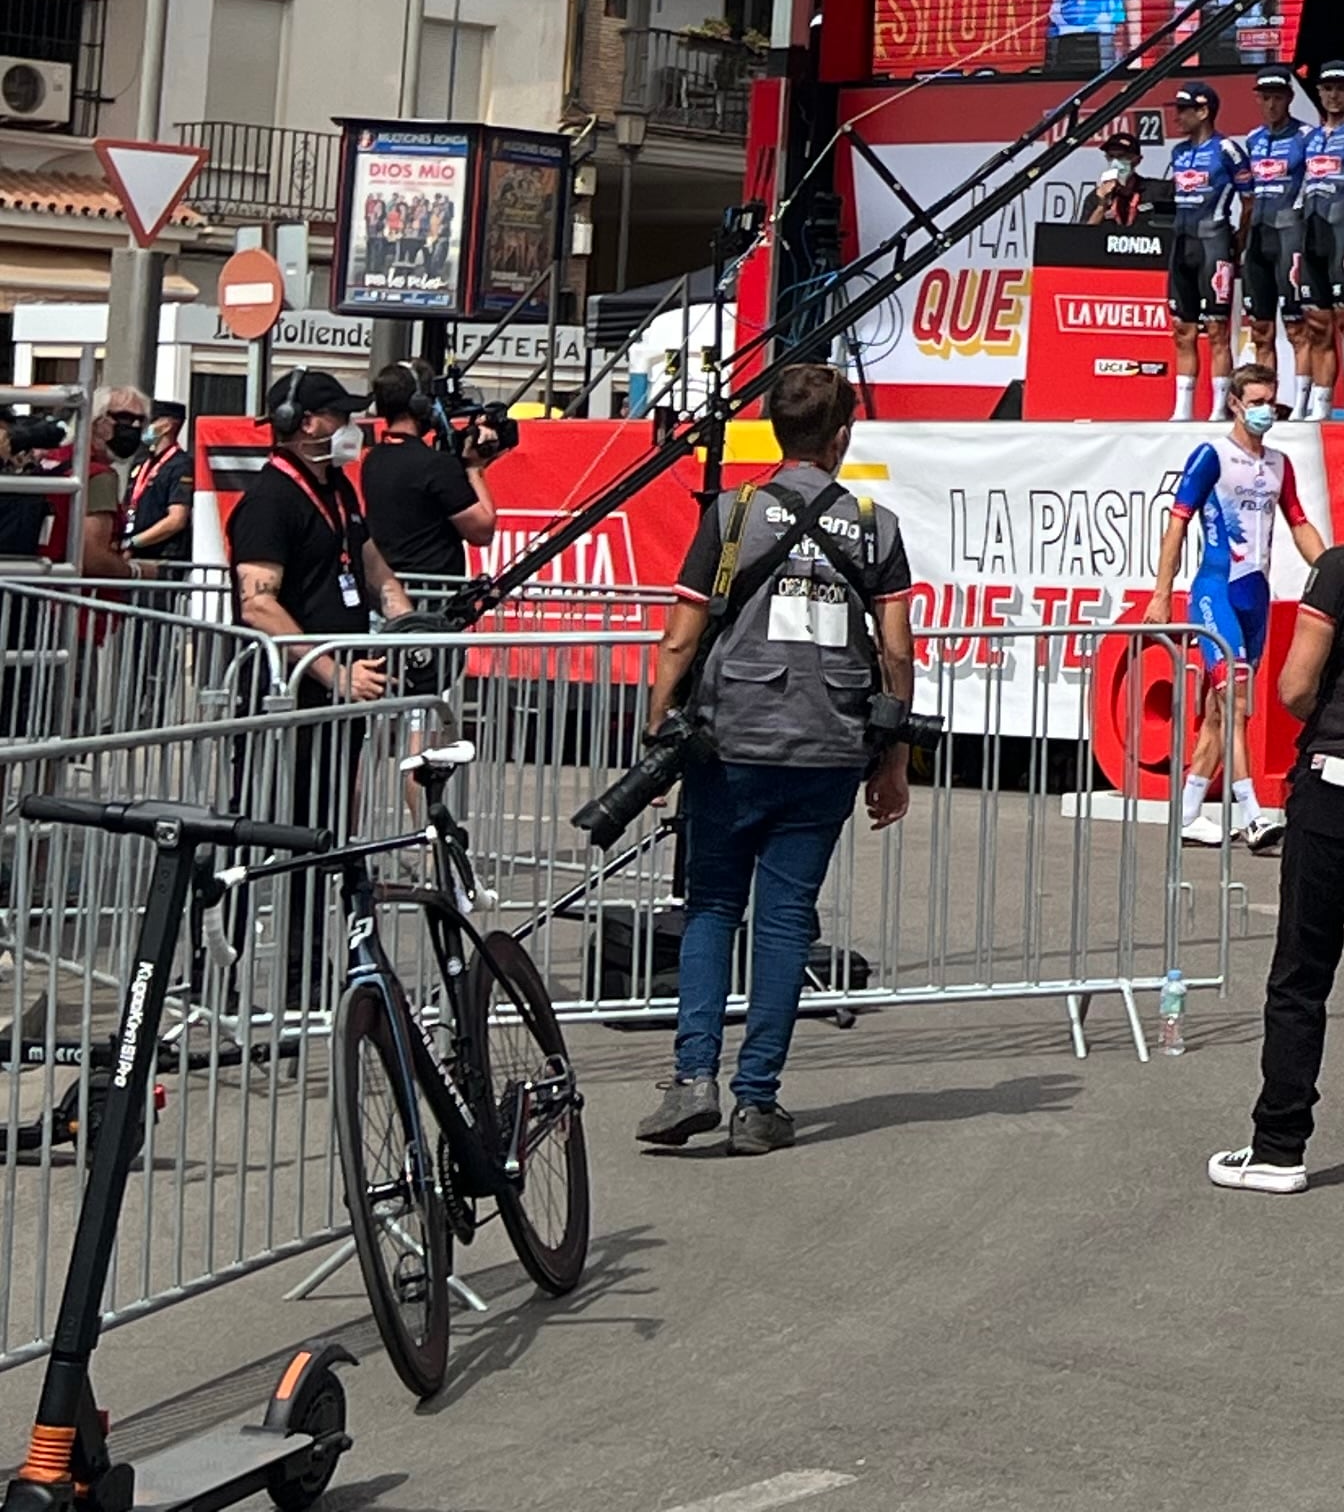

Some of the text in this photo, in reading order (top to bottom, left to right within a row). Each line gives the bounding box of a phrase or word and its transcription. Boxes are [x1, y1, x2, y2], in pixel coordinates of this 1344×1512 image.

[1140, 115, 1160, 141] 22
[369, 162, 413, 178] DIOS
[1107, 235, 1162, 255] RONDA
[913, 267, 1028, 356] QUE
[1067, 301, 1167, 329] LA VUELTA
[949, 469, 1202, 578] LA PASIÓ
[27, 1046, 89, 1063] mcro
